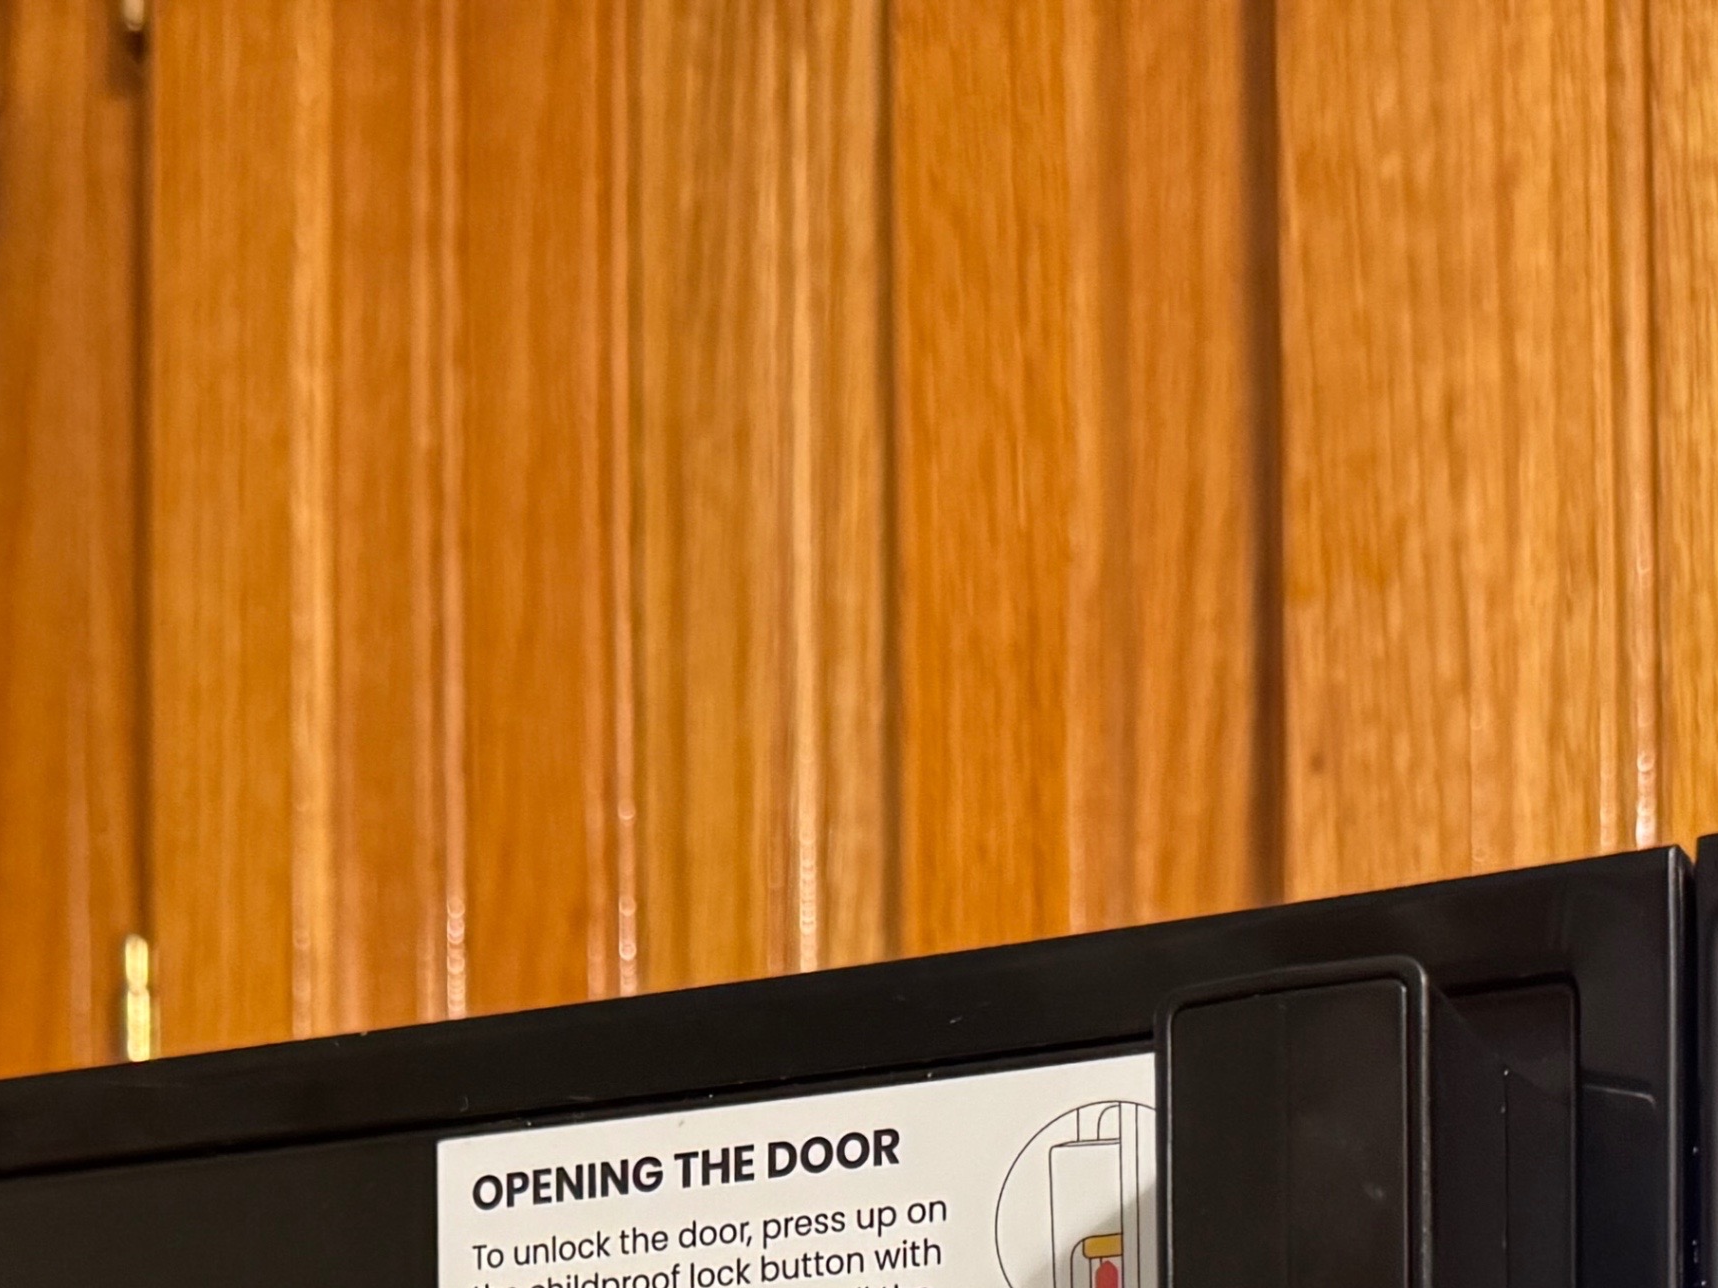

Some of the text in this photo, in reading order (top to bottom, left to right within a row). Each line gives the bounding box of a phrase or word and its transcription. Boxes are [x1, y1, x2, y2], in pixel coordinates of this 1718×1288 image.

[473, 1128, 899, 1210] OPENING THE DOOR
[472, 1200, 946, 1270] To unlock the door, press up on
[690, 1258, 750, 1288] lock
[761, 1251, 864, 1282] button
[874, 1238, 941, 1270] with
